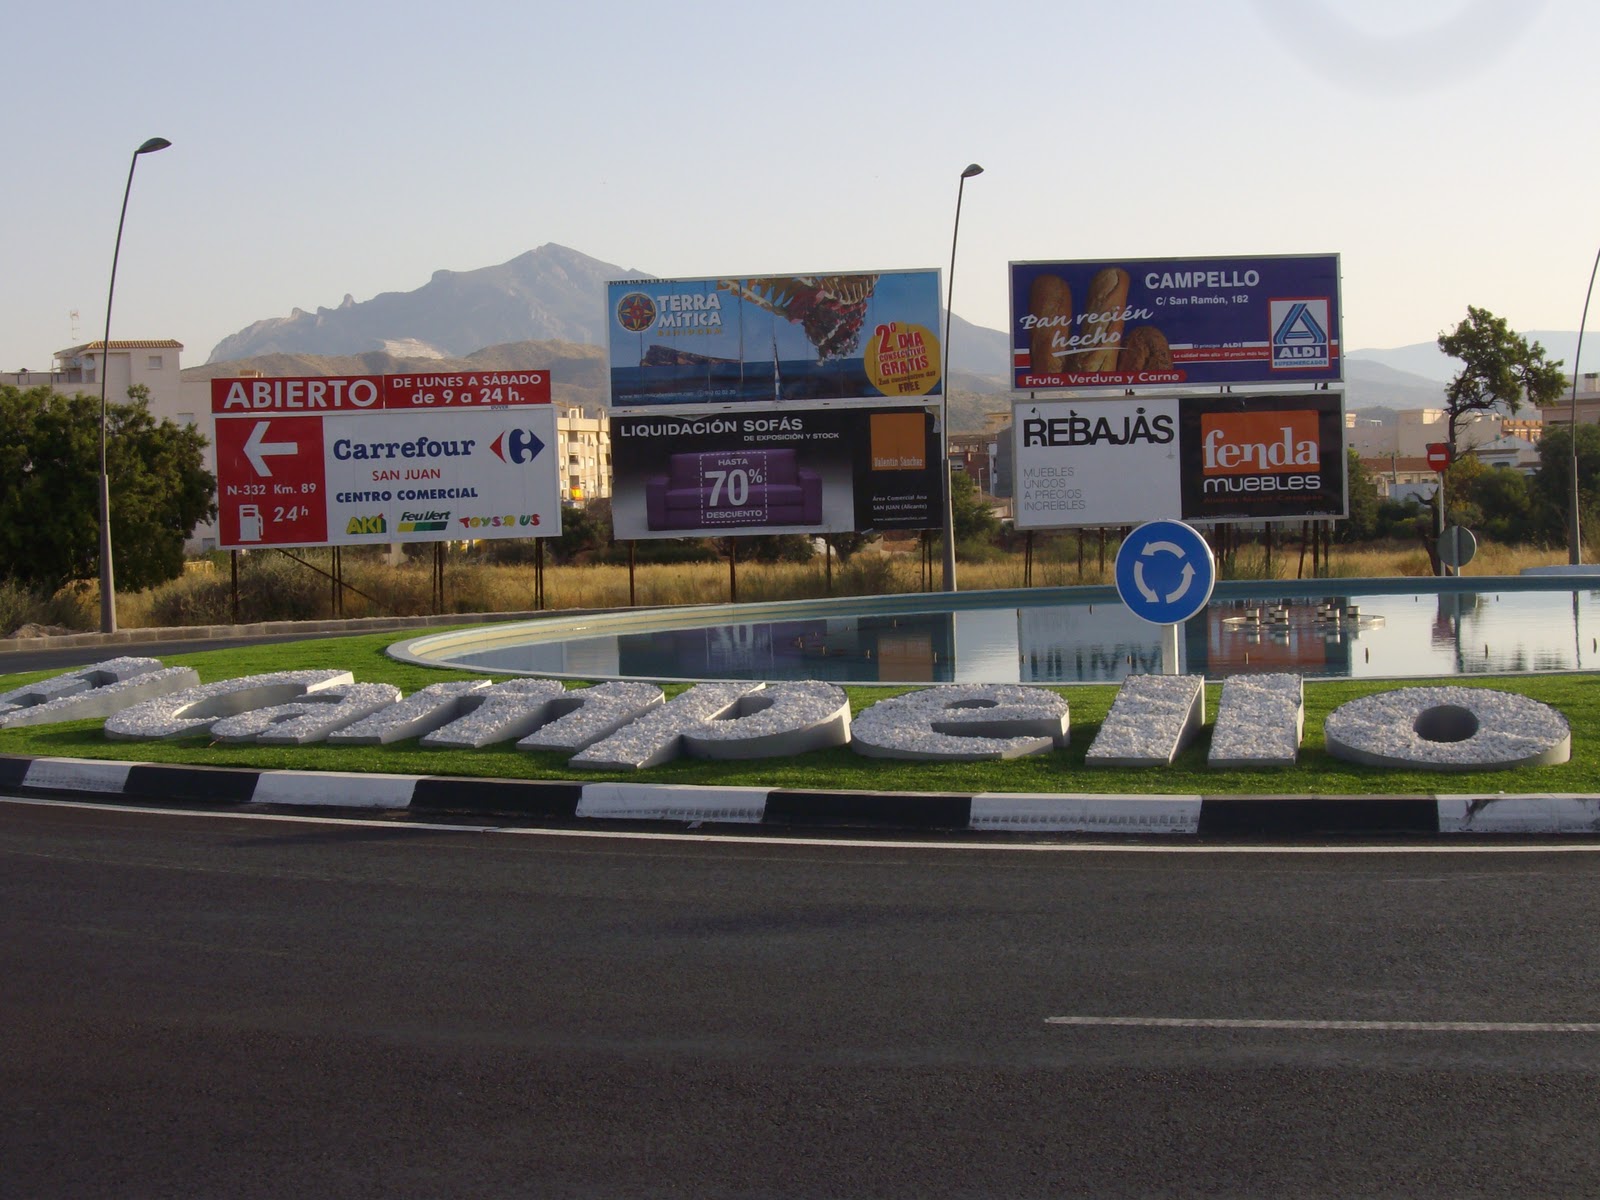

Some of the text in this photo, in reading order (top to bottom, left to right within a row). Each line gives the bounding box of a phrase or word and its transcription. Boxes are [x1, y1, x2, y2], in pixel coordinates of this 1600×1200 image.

[1145, 269, 1260, 289] CAMPELLO
[657, 293, 721, 312] TERRA
[1155, 295, 1249, 306] C/ San Ramón, 182
[1019, 304, 1154, 330] Pan recién
[1051, 326, 1121, 348] hecho
[878, 345, 926, 362] CONSECUTIVO
[1278, 346, 1321, 358] ALDI
[880, 355, 930, 376] GRATIS
[393, 373, 542, 388] DE LUNES A SÁBADO
[898, 381, 920, 392] FREE
[1025, 372, 1180, 387] Fruta, Verdura y Carne
[223, 379, 378, 409] ABIERTO
[412, 389, 435, 404] de
[442, 389, 454, 403] 9
[460, 392, 472, 403] a
[620, 416, 803, 437] LIQUIDACIÓN SOFÁS
[756, 432, 804, 441] EXPOSICIÓN
[812, 432, 840, 440] STOCK
[333, 437, 476, 460] Carrefour
[1202, 427, 1319, 470] fenda
[718, 458, 749, 466] HASTA
[372, 468, 441, 482] SAN JUAN
[1023, 467, 1075, 478] MUEBLES
[227, 482, 316, 496] N-332 Km. 89
[336, 487, 478, 503] CENTRO COMERCIAL
[704, 468, 763, 508] 70%
[1024, 489, 1082, 500] A PRECIOS
[706, 509, 763, 519] DESCUENTO
[346, 513, 387, 535] AKI
